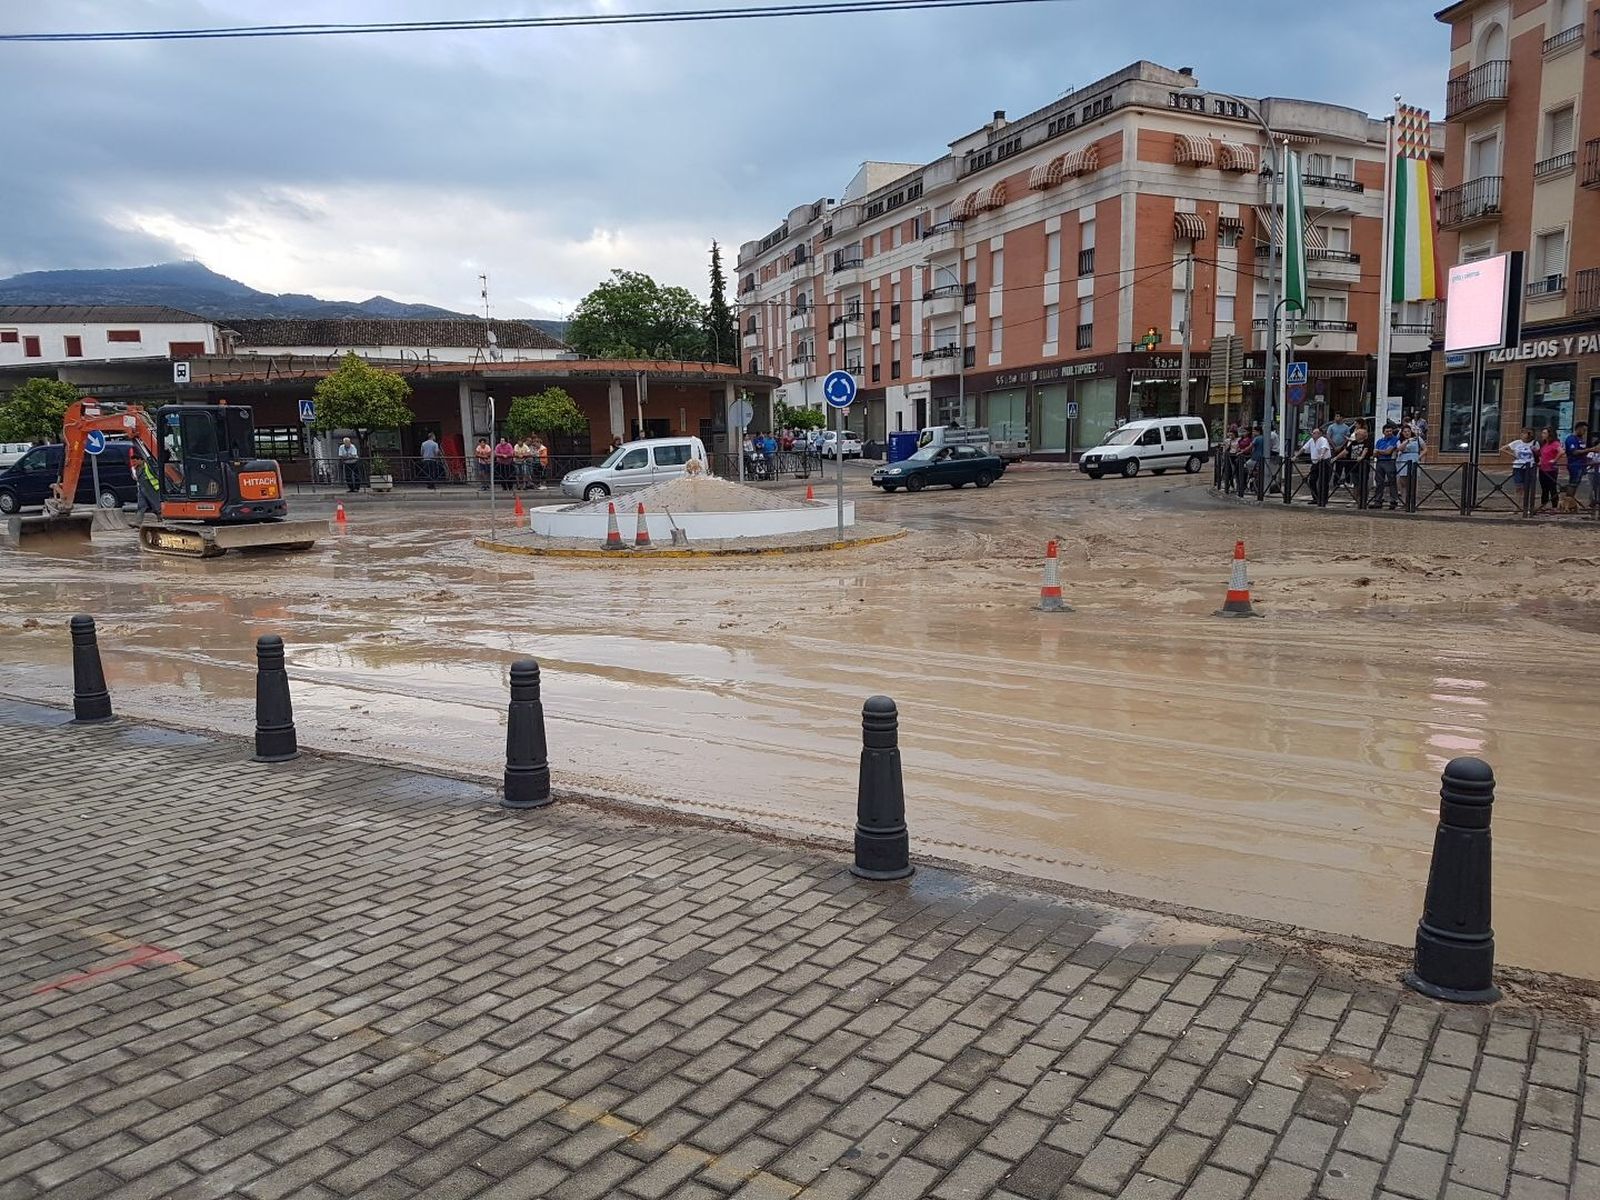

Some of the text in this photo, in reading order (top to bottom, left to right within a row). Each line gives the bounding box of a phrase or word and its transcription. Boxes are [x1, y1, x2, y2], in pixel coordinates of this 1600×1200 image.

[1488, 339, 1559, 363] AZULEJOS
[1562, 337, 1574, 355] Y
[243, 477, 277, 487] HITACHI
